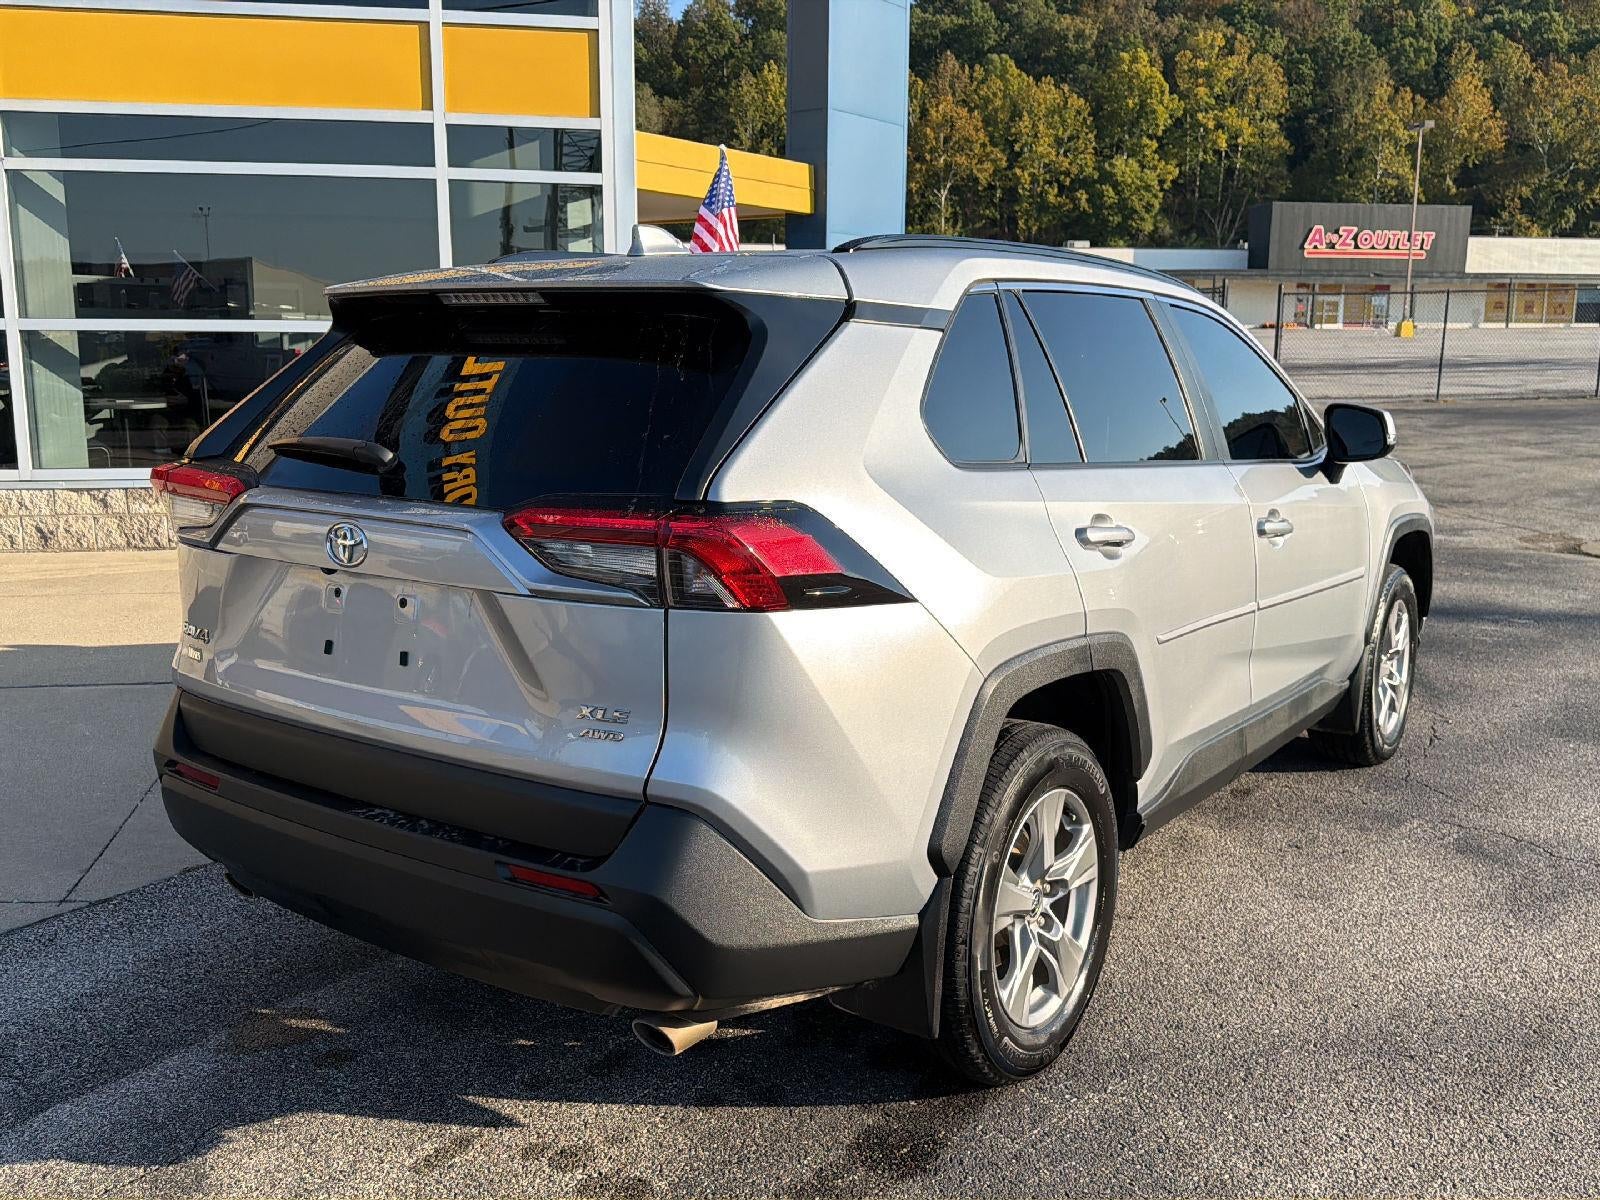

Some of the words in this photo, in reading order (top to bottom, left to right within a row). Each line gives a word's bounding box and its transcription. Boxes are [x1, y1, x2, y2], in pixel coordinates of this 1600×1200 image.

[1357, 230, 1435, 250] OUTLET
[576, 704, 631, 725] XLE
[579, 727, 624, 742] AWD
